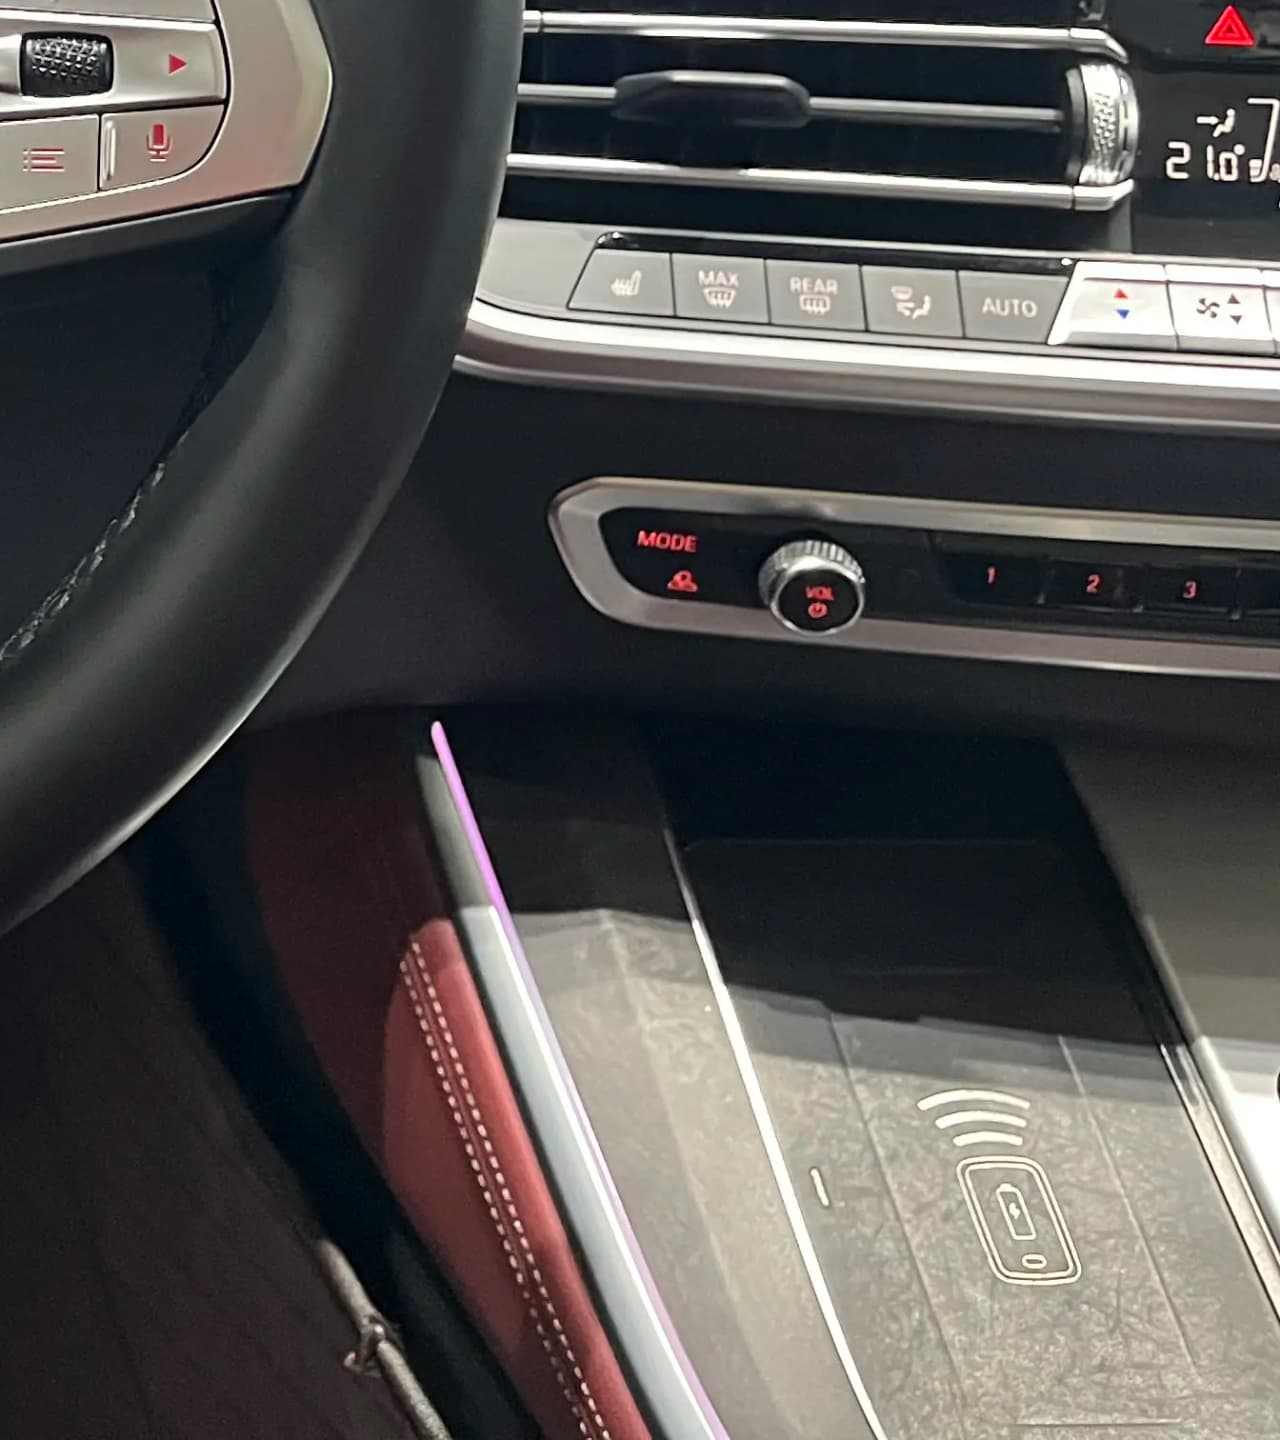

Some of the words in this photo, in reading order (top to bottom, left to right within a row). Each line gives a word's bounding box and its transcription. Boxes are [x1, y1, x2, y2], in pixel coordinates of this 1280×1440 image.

[698, 270, 739, 287] MAX
[790, 277, 838, 294] REAR
[981, 297, 1038, 318] AUTO
[637, 530, 697, 552] MODE
[987, 566, 996, 584] 1
[1086, 574, 1102, 593] 2
[805, 586, 834, 601] VOL
[1183, 581, 1197, 599] 3
